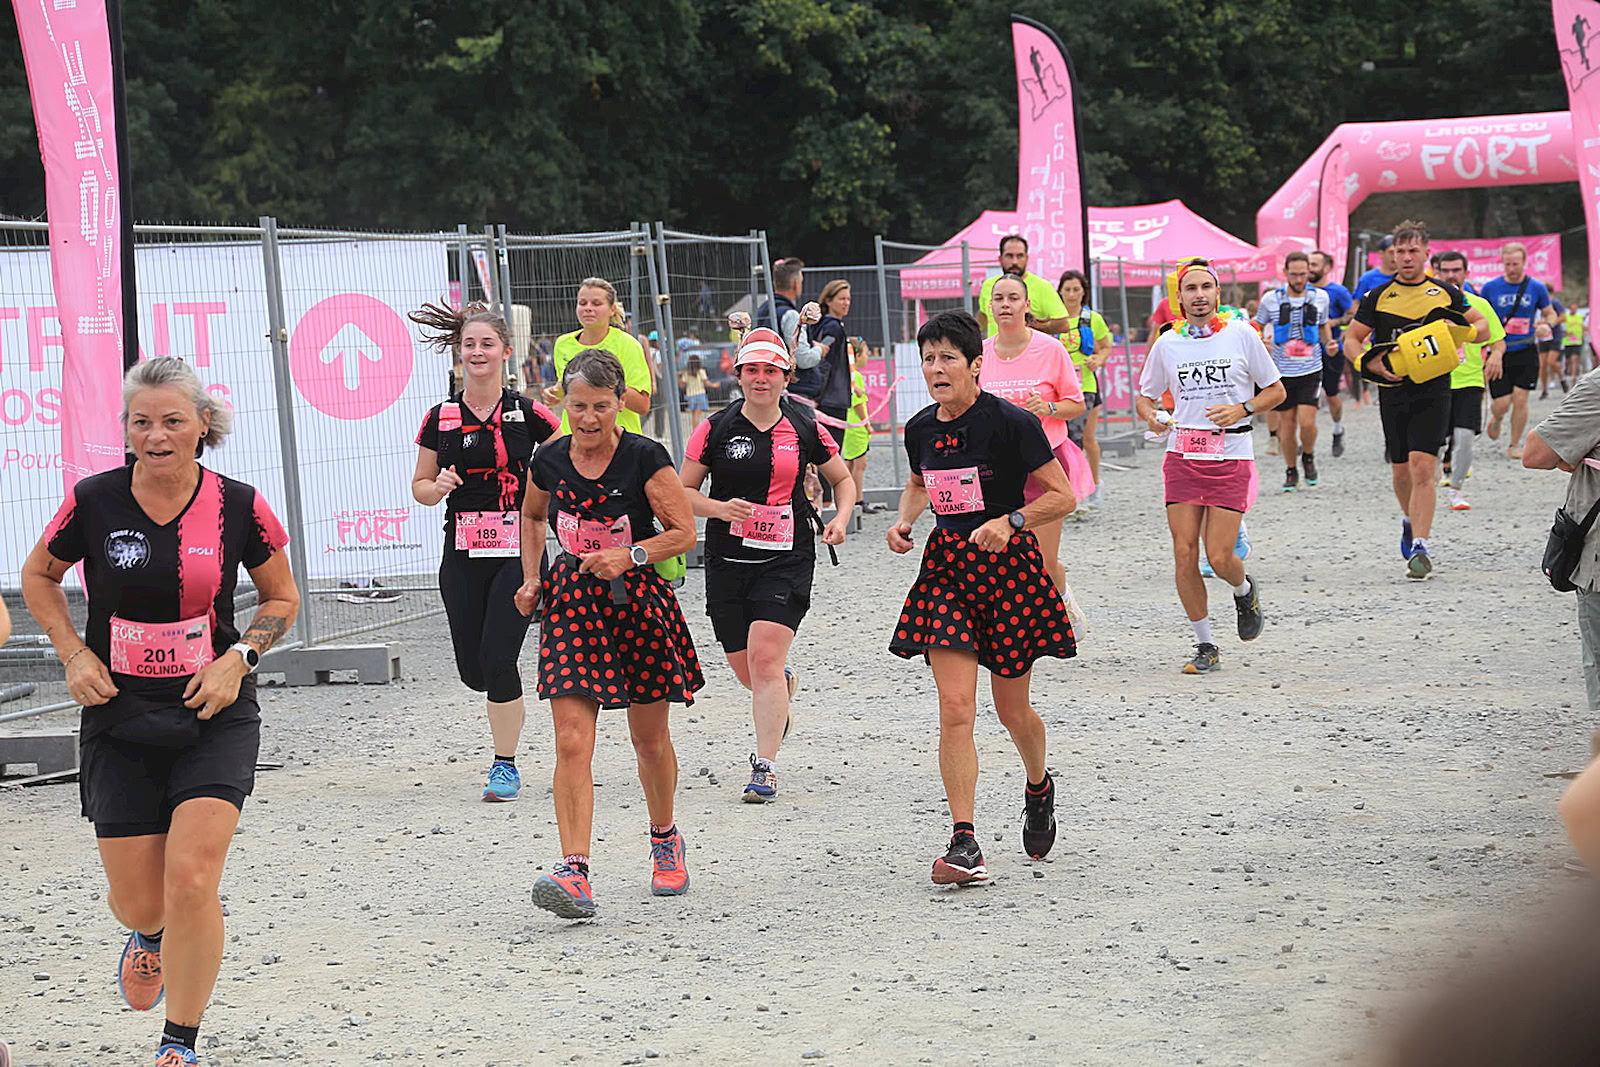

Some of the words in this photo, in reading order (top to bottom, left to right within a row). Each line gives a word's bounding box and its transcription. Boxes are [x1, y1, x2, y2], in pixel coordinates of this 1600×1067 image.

[1425, 127, 1452, 138] LA
[1454, 122, 1518, 136] ROUTE
[1520, 121, 1547, 132] DU
[1421, 133, 1552, 181] FORT
[1133, 215, 1170, 232] DU
[1089, 229, 1163, 261] RT
[1189, 360, 1218, 368] ROUTE
[1190, 437, 1207, 446] 548
[938, 490, 952, 502] 32
[333, 510, 349, 518] LA
[353, 508, 391, 517] ROUTE
[337, 516, 410, 544] FORT
[753, 521, 774, 532] 187
[476, 528, 497, 539] 189
[747, 531, 777, 541] AURORE
[472, 540, 501, 548] MELODY
[584, 539, 601, 550] 36
[188, 547, 214, 555] POLI
[112, 626, 144, 641] FORT
[144, 648, 176, 662] 201
[136, 664, 186, 675] COLINDA
